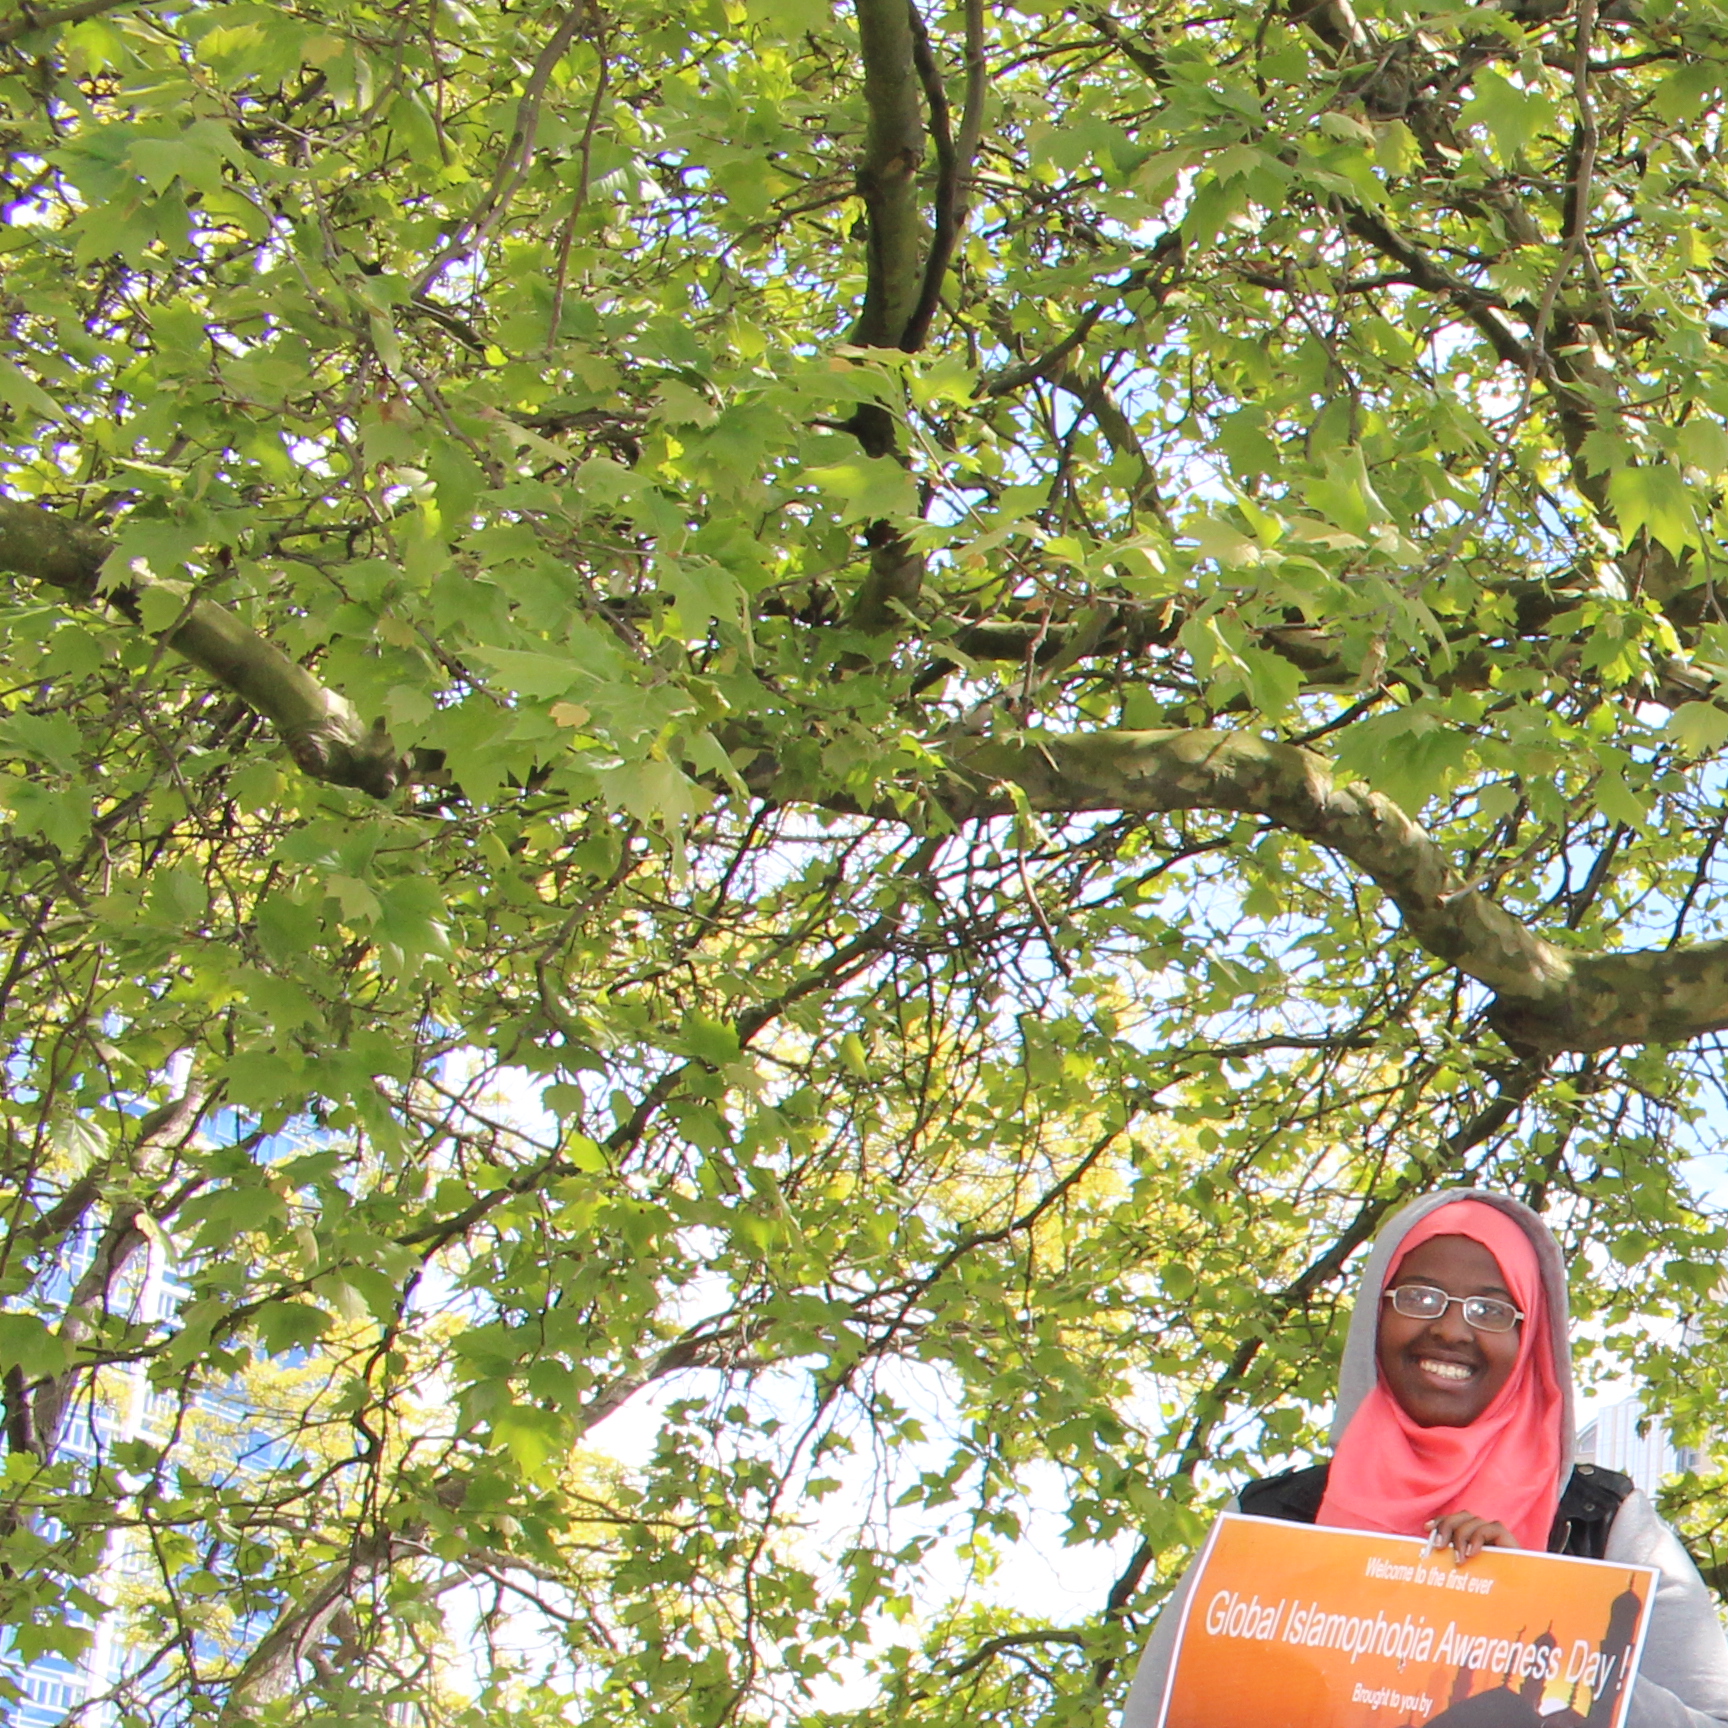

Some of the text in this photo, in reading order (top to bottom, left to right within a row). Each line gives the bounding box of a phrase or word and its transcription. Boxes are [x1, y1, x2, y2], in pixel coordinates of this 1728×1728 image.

[1365, 1556, 1494, 1595] Welcome to the first ever
[1205, 1589, 1286, 1641] Global
[1281, 1598, 1435, 1664] Islamophobia
[1432, 1620, 1562, 1681] Awareness
[1564, 1639, 1617, 1701] Day
[1352, 1682, 1433, 1718] Brought to you by
